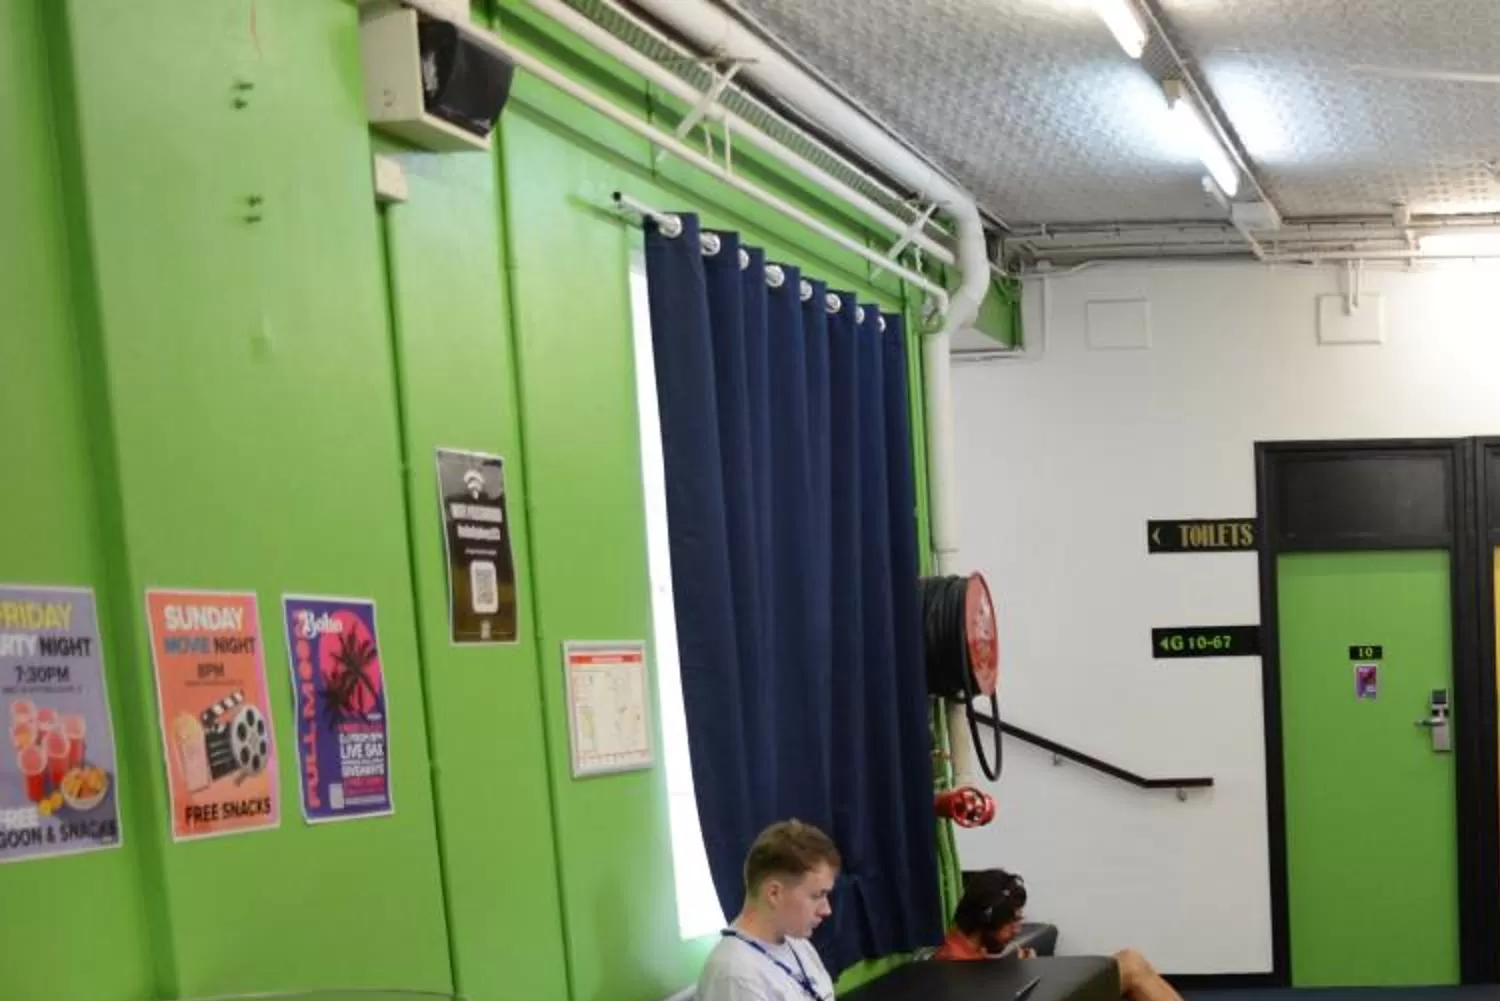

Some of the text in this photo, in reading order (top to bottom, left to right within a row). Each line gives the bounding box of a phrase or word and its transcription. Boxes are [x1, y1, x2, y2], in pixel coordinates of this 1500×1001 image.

[1177, 522, 1254, 547] TOILETS
[163, 604, 244, 632] SUNDAY
[0, 634, 92, 657] RTY NIGHT
[213, 636, 255, 656] NIGHT
[1169, 635, 1232, 651] G 10-67
[1359, 647, 1374, 657] 10
[15, 664, 70, 684] 7:30PM
[184, 796, 271, 825] FREE SNACKS
[60, 819, 118, 844] SNACKS
